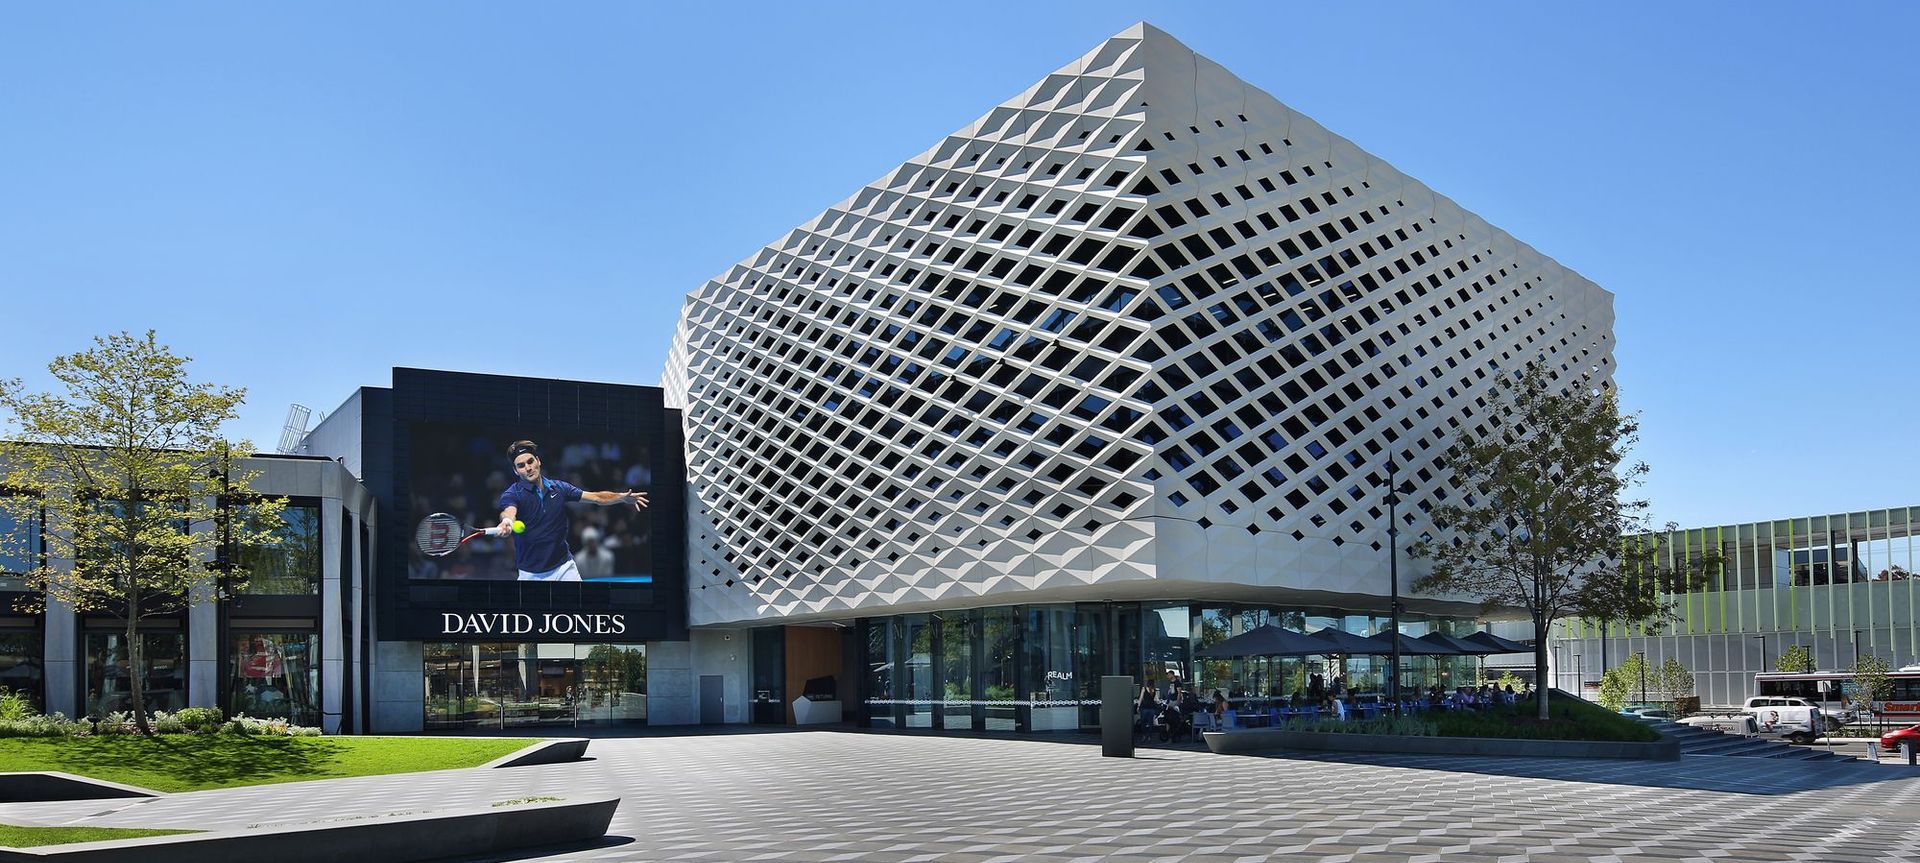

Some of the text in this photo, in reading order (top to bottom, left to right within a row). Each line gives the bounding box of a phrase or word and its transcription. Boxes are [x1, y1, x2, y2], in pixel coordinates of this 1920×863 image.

[442, 613, 626, 634] DAVID JONES
[1047, 670, 1073, 681] REALM
